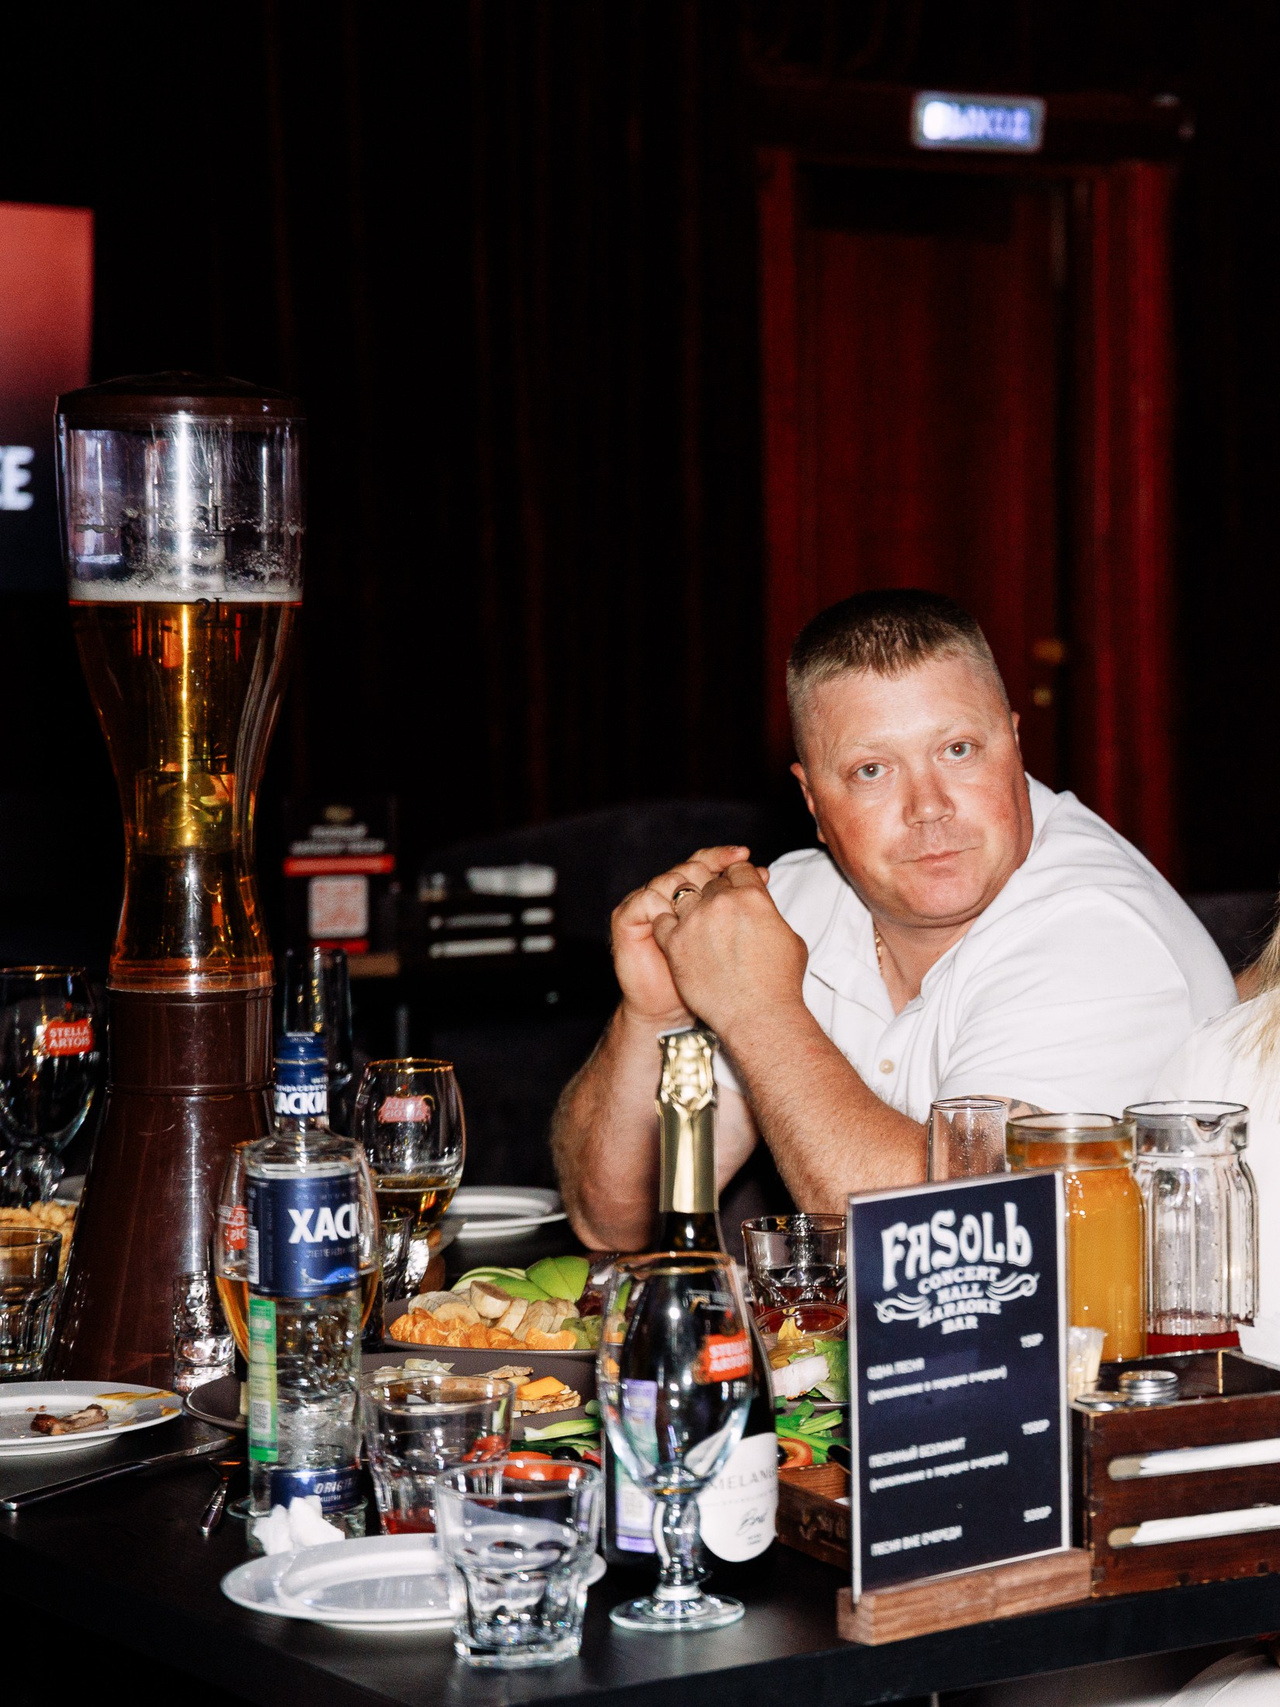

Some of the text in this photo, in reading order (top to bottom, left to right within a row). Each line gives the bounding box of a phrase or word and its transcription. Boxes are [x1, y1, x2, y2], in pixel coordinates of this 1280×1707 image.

[50, 1026, 90, 1038] STELLA
[50, 1036, 91, 1049] ARTOIS
[918, 1265, 1001, 1294] CONCERT
[936, 1283, 984, 1304] HALL
[918, 1299, 1001, 1329] KARAOKE
[941, 1315, 979, 1335] BAR
